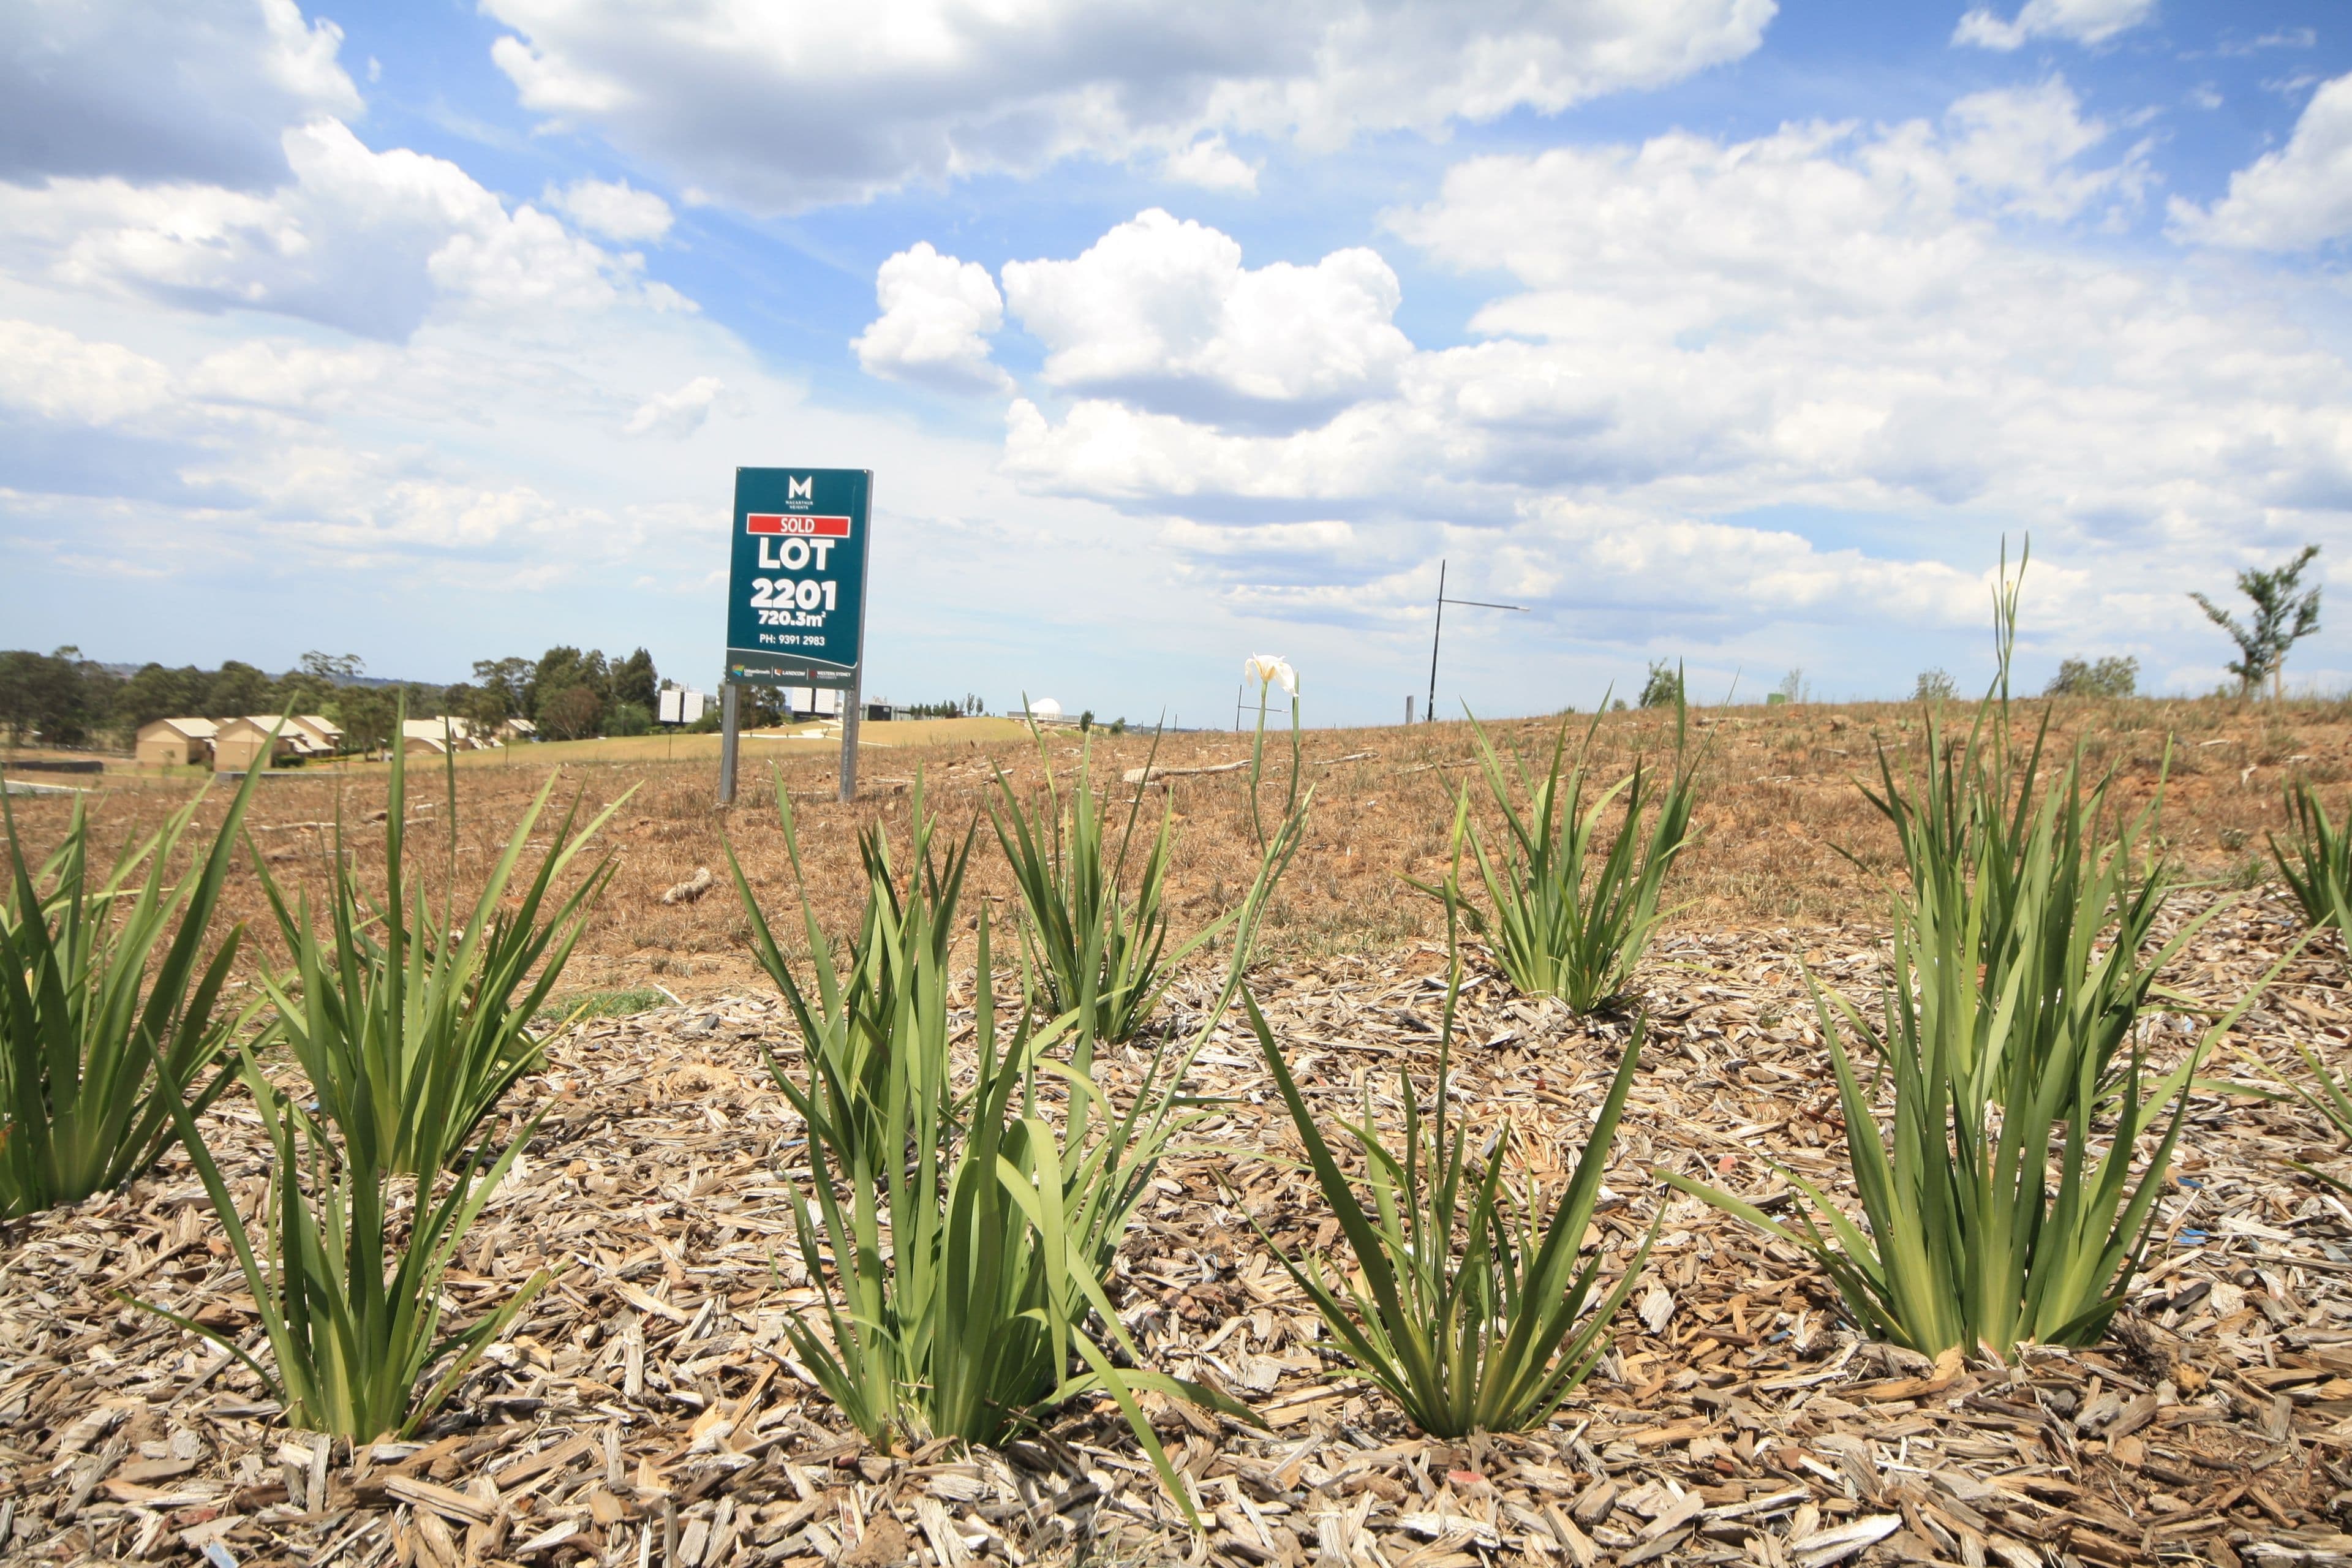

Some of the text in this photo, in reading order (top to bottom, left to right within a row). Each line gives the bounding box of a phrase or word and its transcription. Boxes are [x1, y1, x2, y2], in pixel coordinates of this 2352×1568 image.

[780, 518, 815, 533] SOLD
[758, 537, 835, 571] LOT
[750, 578, 836, 611] 2201
[758, 609, 826, 627] 720.3m²
[760, 633, 825, 646] PH: 9391 2983
